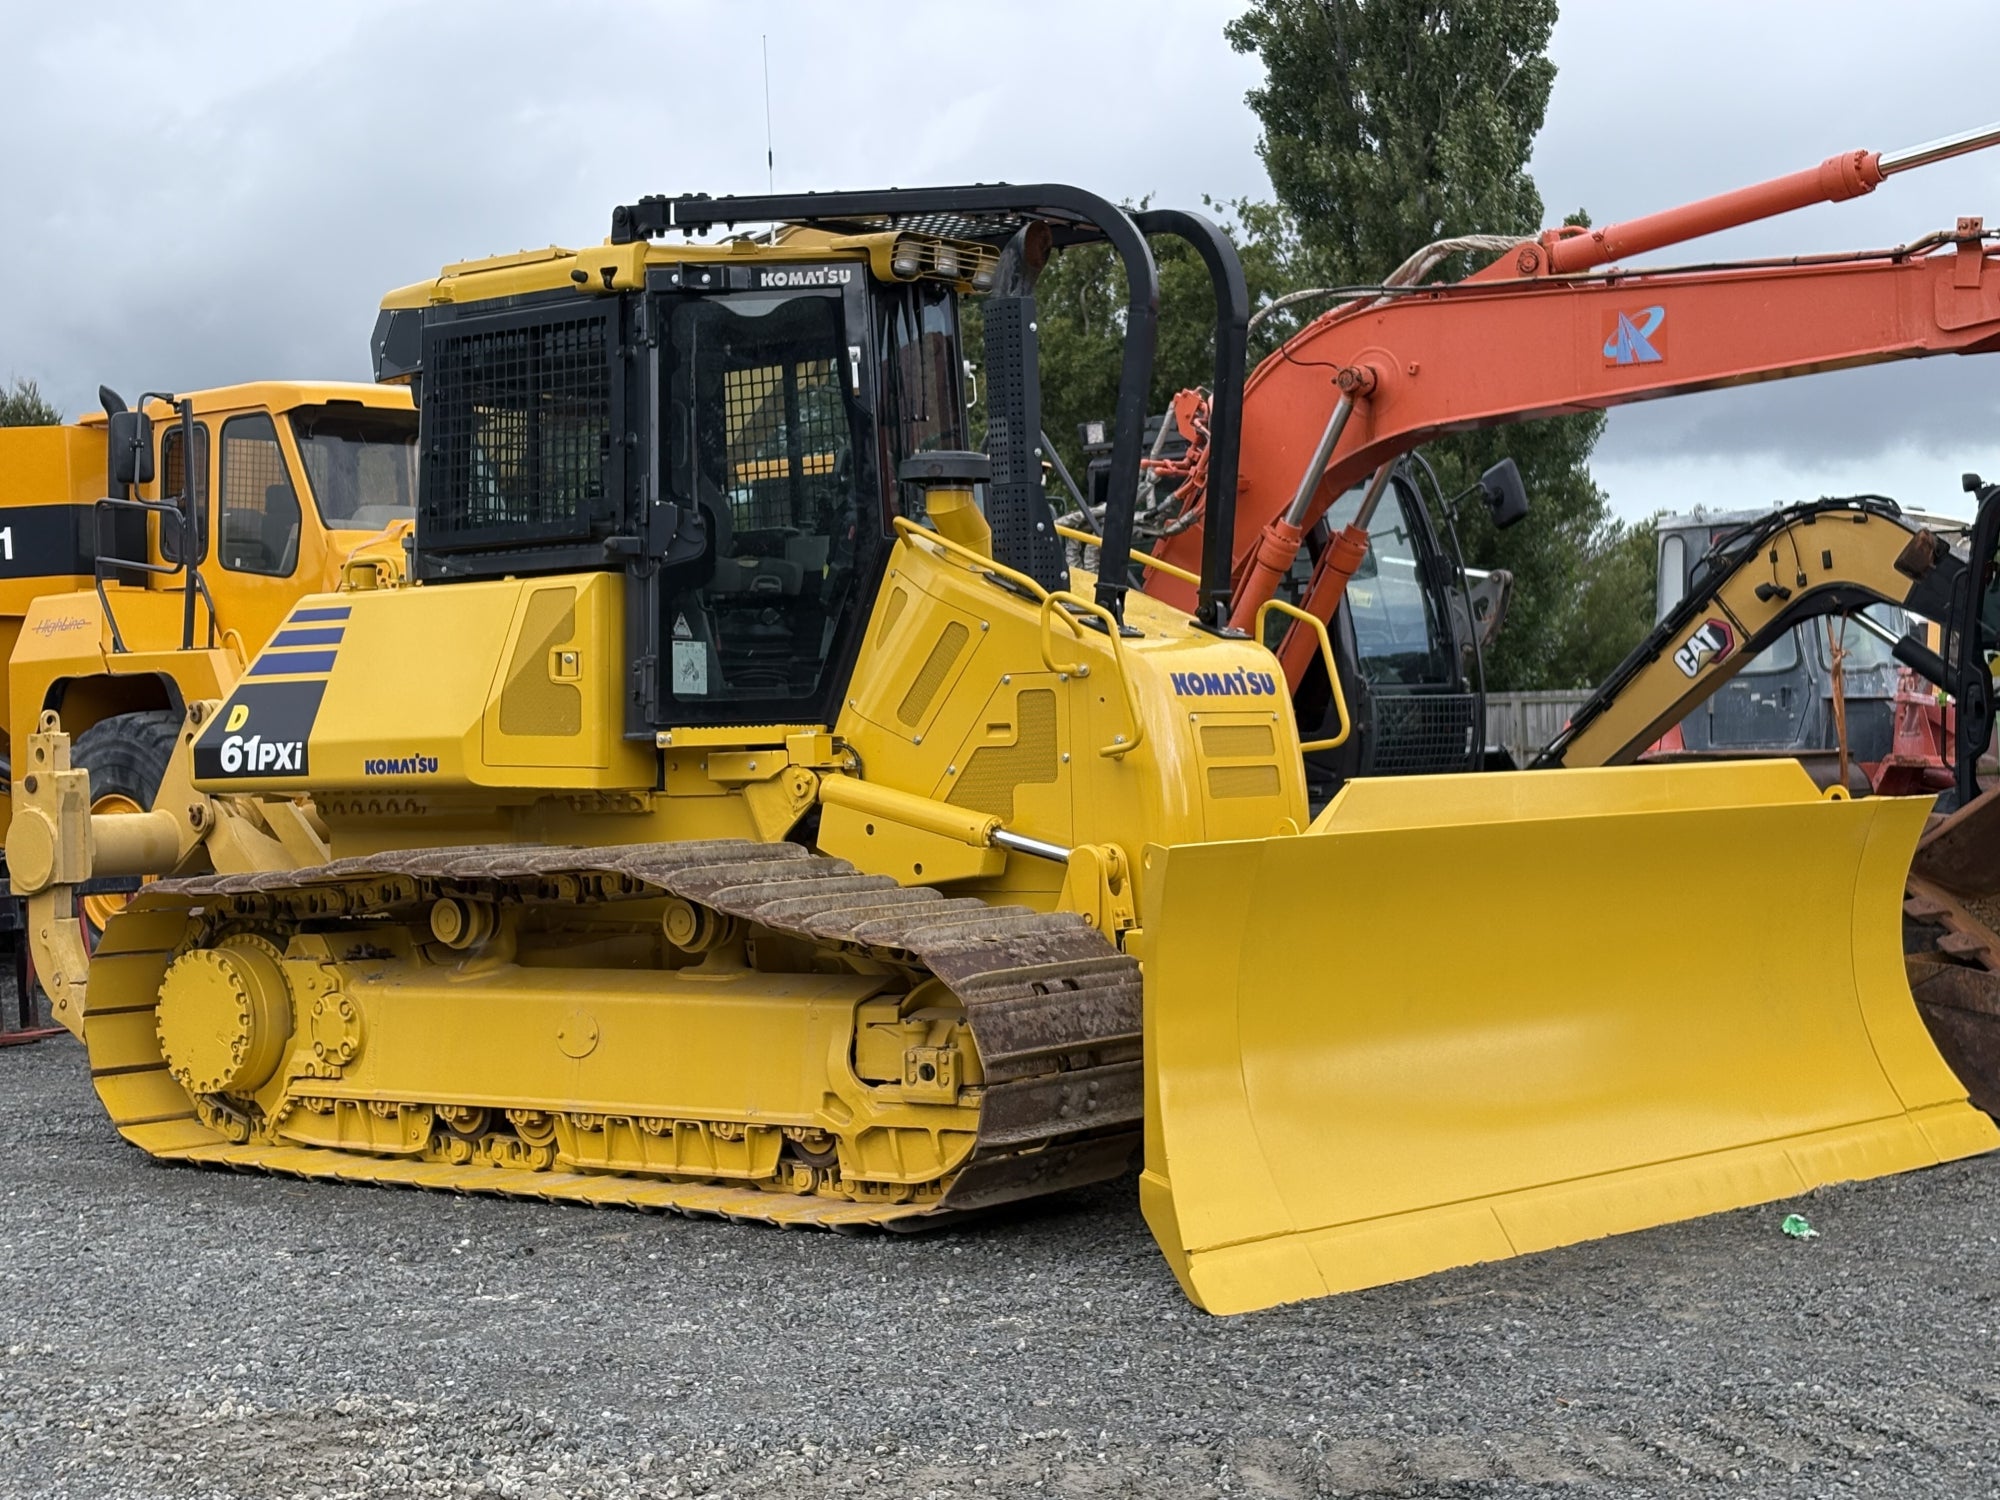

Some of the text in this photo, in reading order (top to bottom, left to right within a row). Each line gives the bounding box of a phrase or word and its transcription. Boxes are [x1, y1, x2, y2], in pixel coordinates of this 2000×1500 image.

[760, 266, 851, 287] KOMATSU
[1674, 623, 1721, 677] CAT
[1170, 665, 1276, 696] KOMATSU
[224, 704, 250, 733] D
[220, 735, 303, 773] 61PXi
[364, 752, 438, 775] KOMATSU
